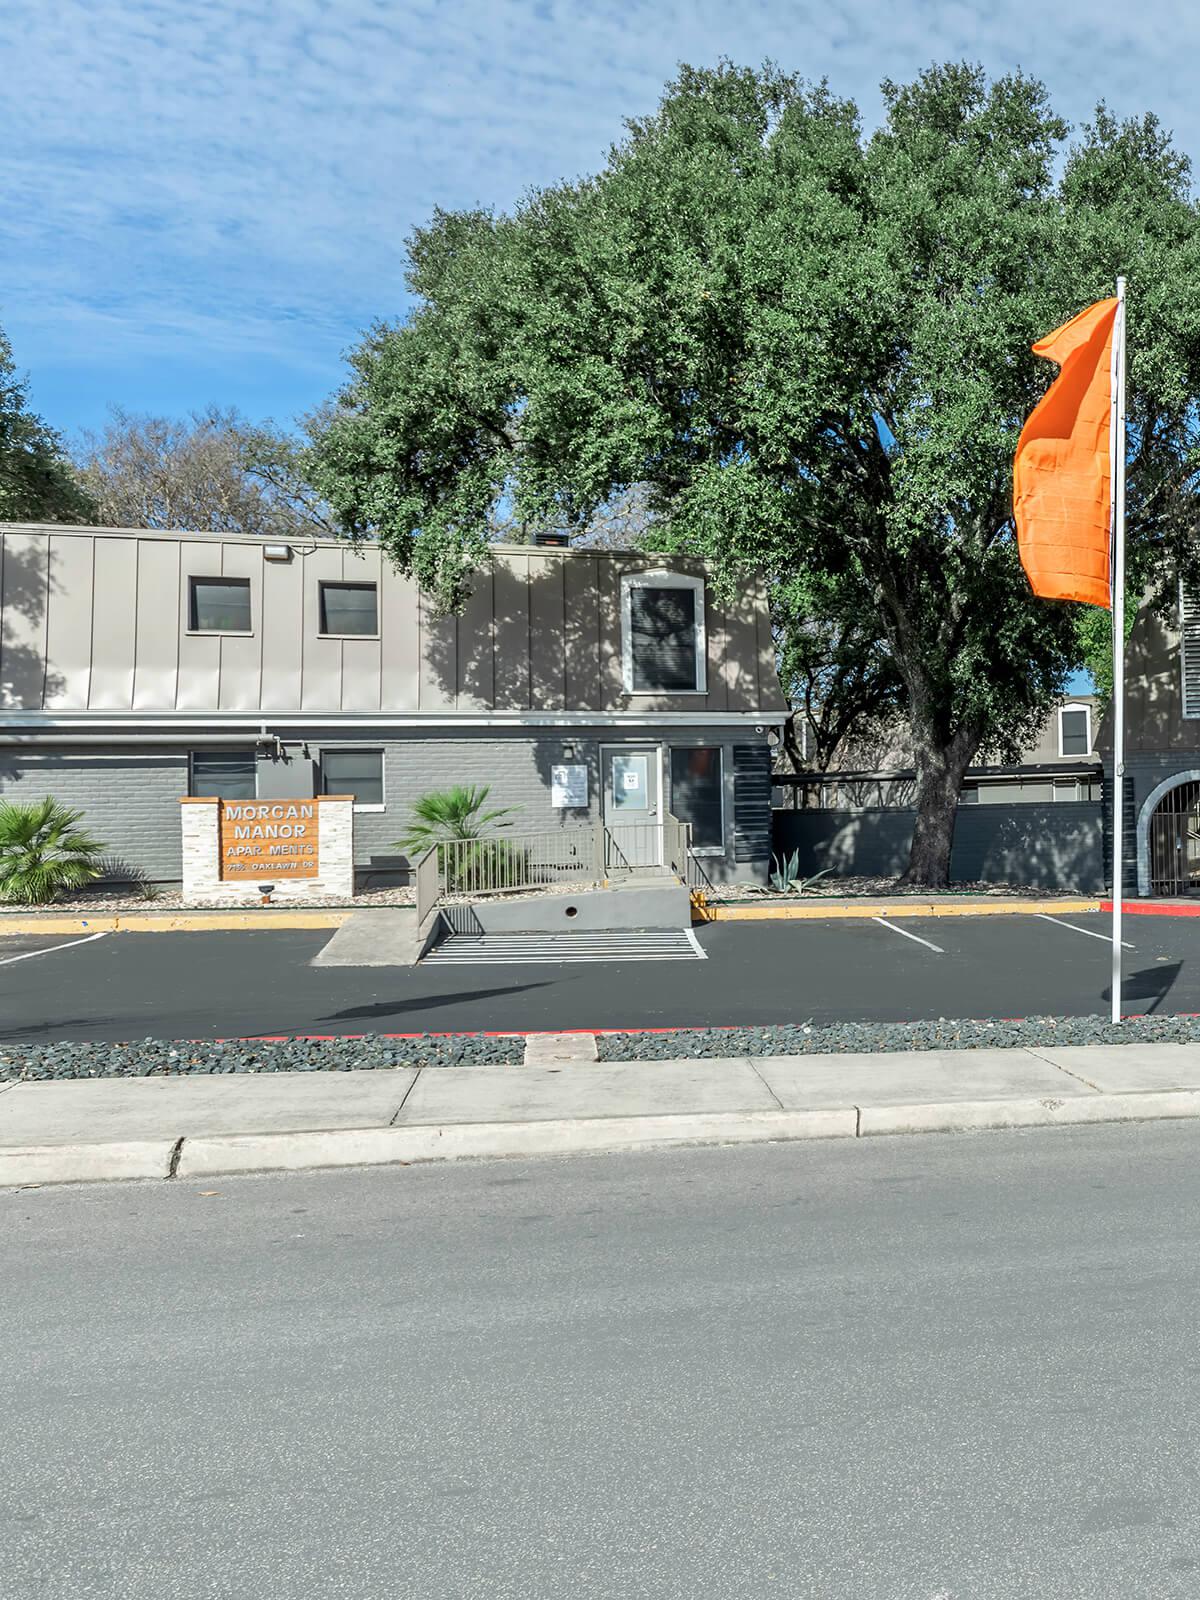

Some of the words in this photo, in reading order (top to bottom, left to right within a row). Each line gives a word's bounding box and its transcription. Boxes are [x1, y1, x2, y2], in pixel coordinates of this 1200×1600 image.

[226, 805, 314, 820] MORGAN
[234, 824, 306, 839] MANOR
[252, 862, 297, 870] OAKLAWN
